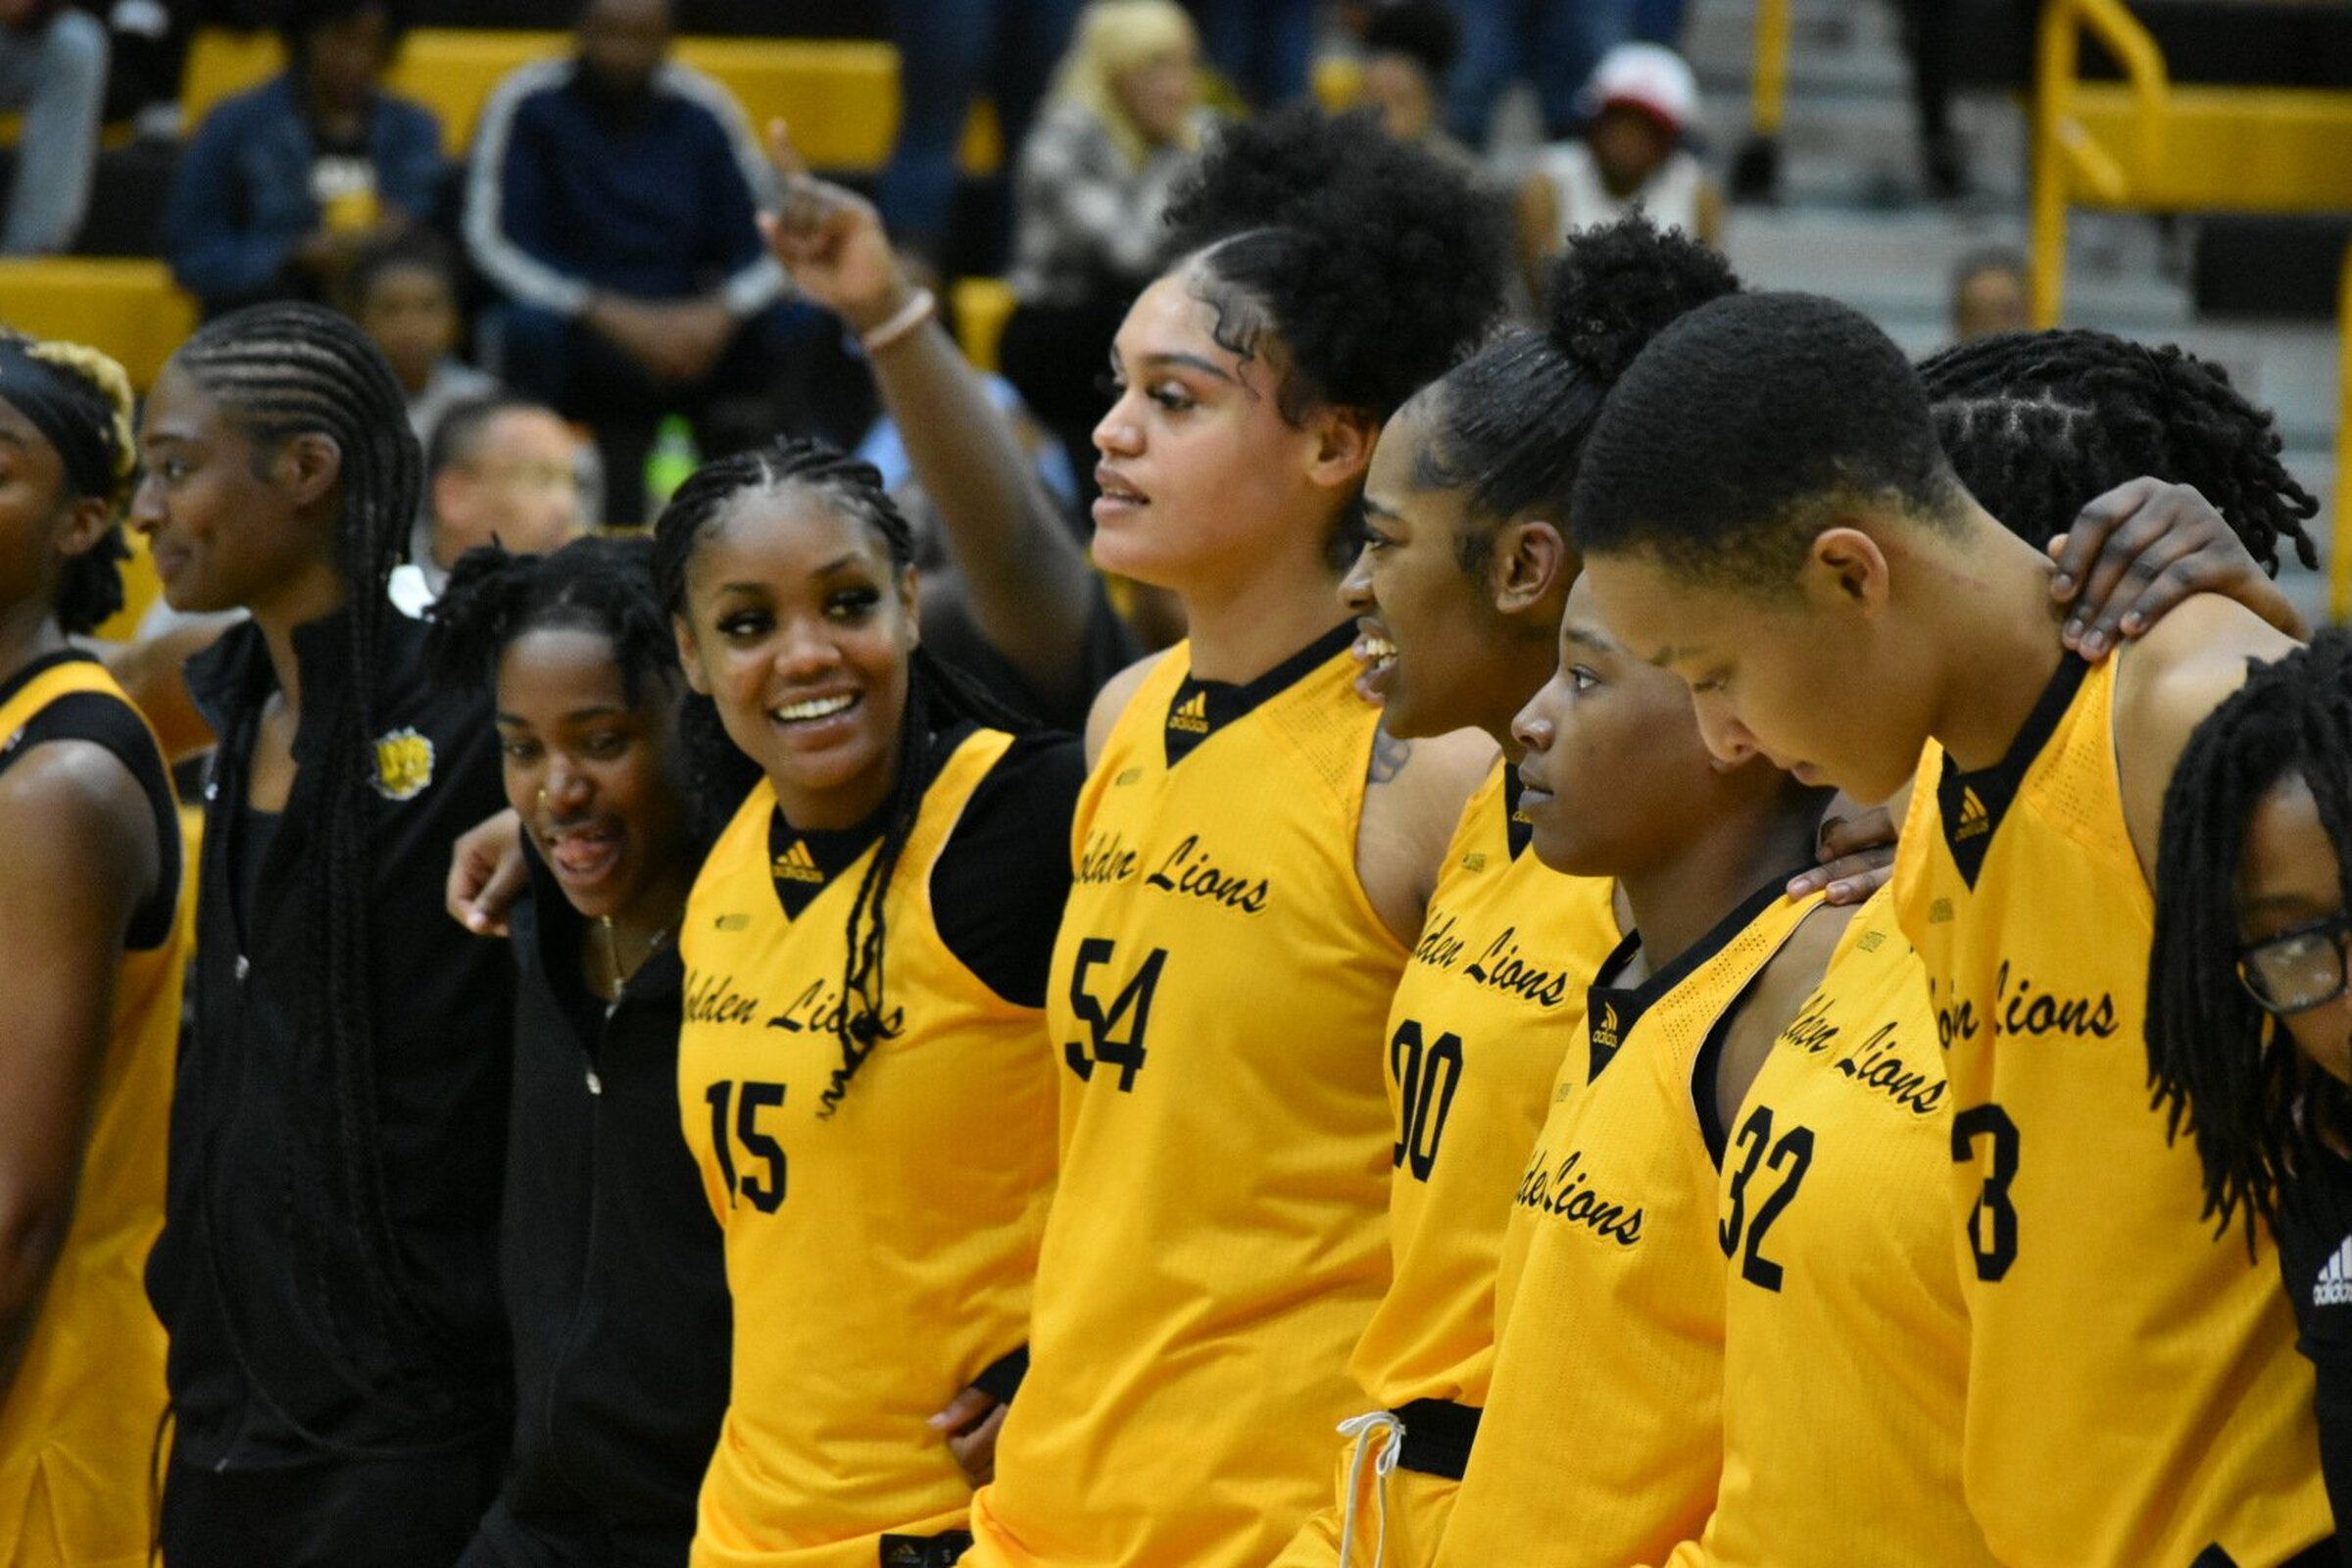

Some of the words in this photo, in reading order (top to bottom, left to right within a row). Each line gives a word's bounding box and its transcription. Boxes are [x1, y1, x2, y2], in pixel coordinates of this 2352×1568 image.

[1145, 834, 1268, 913] Lions
[765, 978, 906, 1040] Lios
[1064, 937, 1168, 1094] 54
[1463, 926, 1568, 1006] Lions
[1834, 1021, 1948, 1113] Lions
[705, 1080, 787, 1215] 15
[1718, 1104, 1815, 1294] 32
[1951, 1103, 2020, 1283] 3
